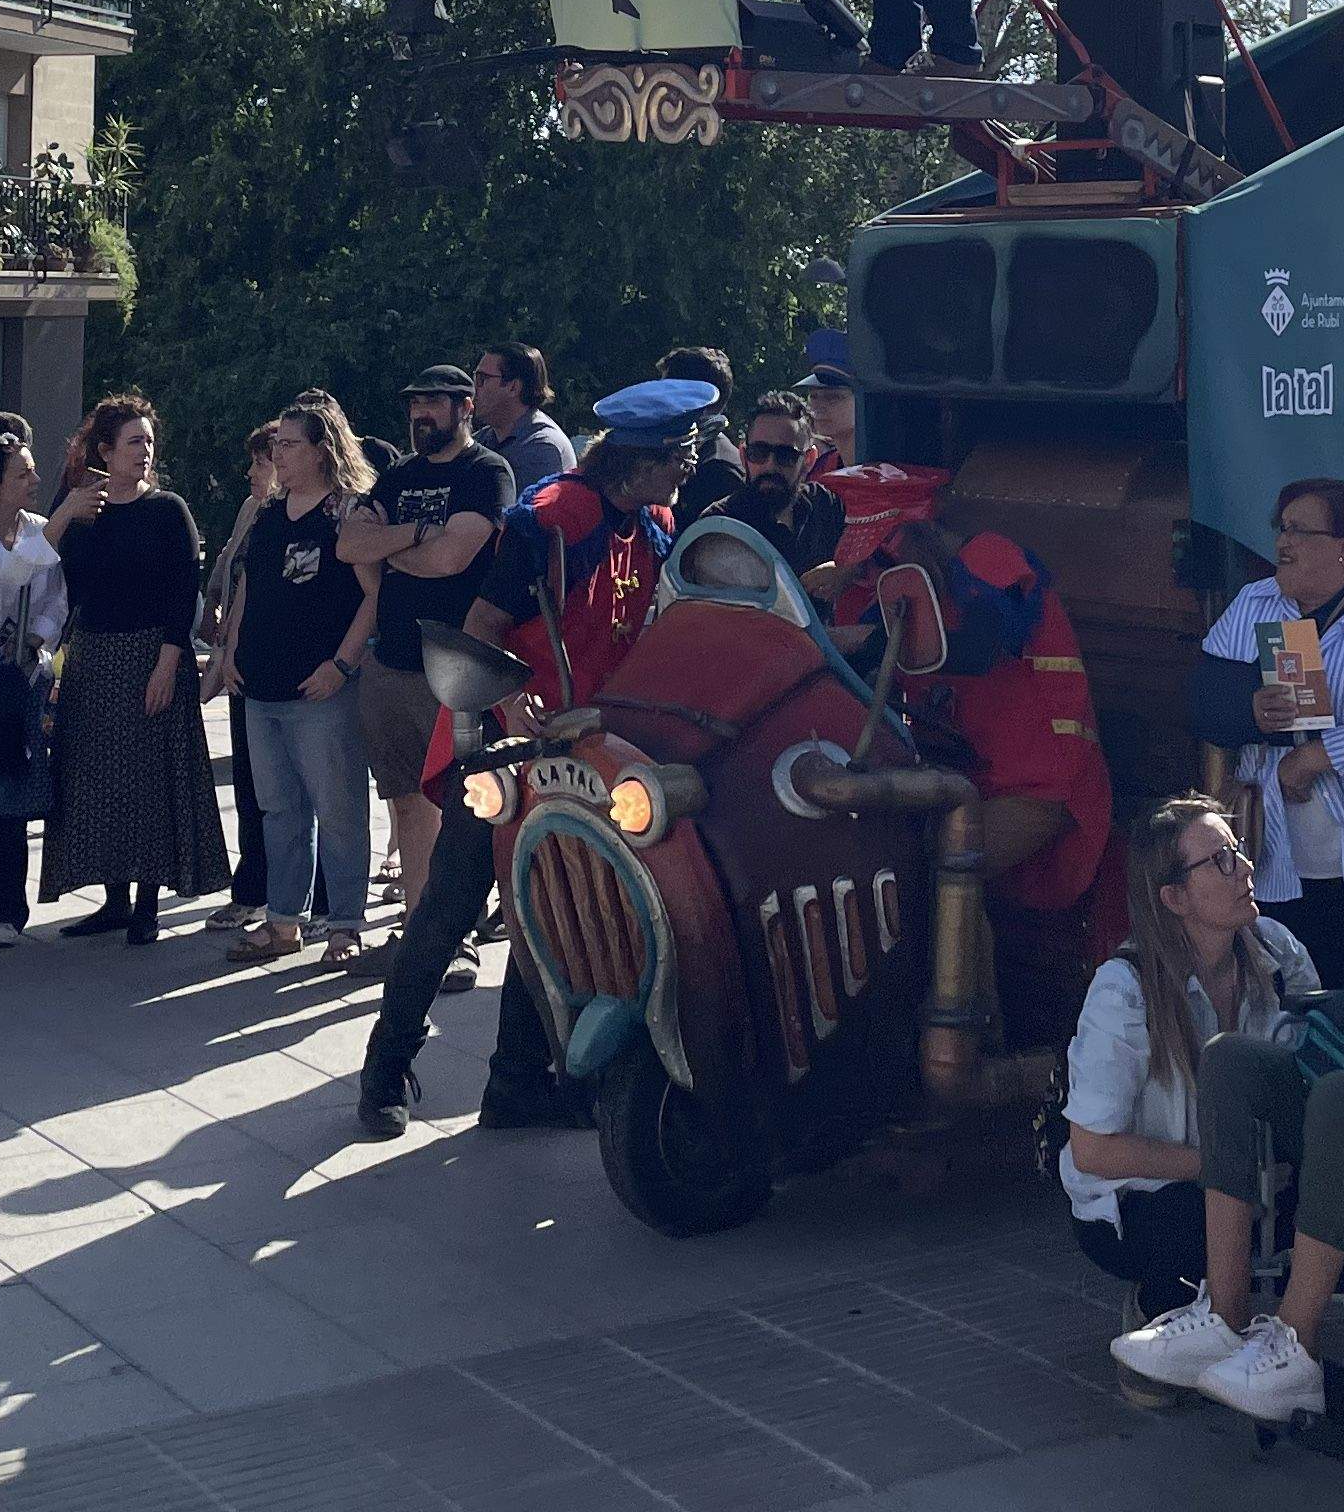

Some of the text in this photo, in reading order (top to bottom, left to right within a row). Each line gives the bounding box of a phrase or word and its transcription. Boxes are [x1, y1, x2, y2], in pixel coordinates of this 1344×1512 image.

[1301, 313, 1315, 328] de
[537, 763, 596, 796] LA TAL
